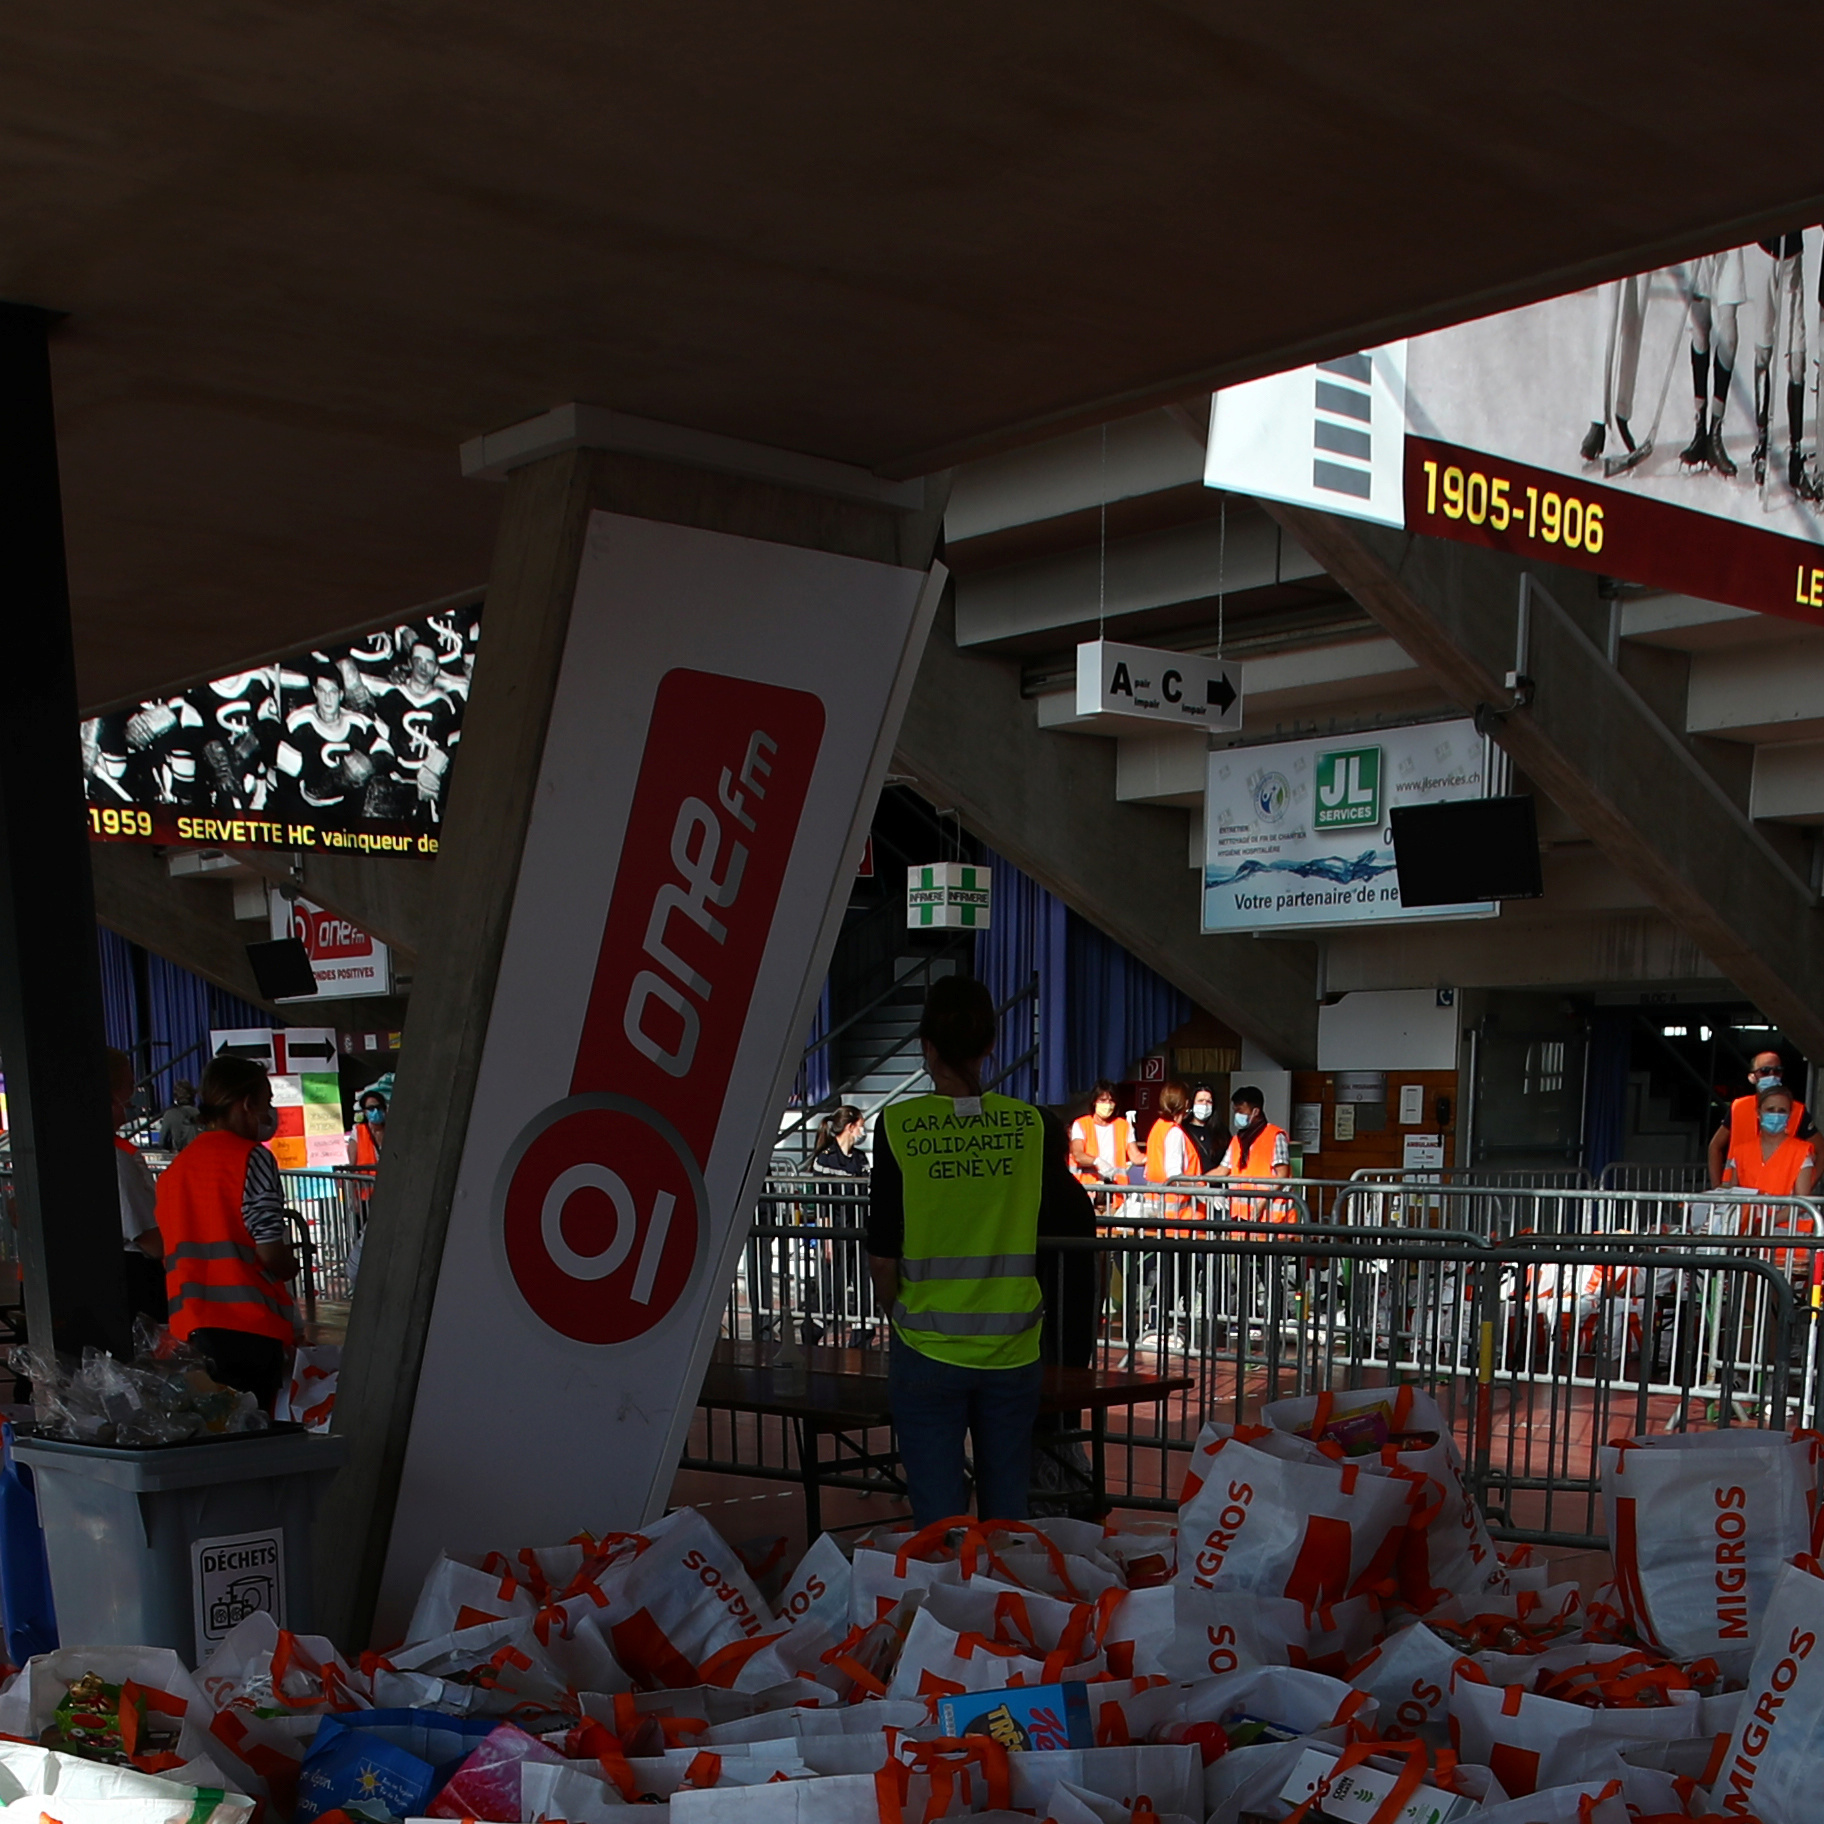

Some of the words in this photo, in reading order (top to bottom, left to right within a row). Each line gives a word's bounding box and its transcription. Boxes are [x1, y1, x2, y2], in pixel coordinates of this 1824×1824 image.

[1422, 460, 1605, 553] 1905-1906
[1110, 661, 1133, 697] A
[1162, 669, 1183, 703] C
[1319, 756, 1374, 807] JL
[1395, 772, 1481, 793] www.jlservices.ch
[1319, 805, 1373, 822] SERVICES
[177, 816, 283, 845] SERVETTE
[287, 823, 317, 847] HC
[321, 828, 414, 855] vainqueur
[909, 891, 944, 902] INFIRMERIE
[947, 891, 988, 903] INFIRMERIE
[1234, 891, 1273, 911] Votre
[1276, 887, 1352, 911] partenaire
[1356, 885, 1375, 902] de
[337, 967, 375, 979] POSITIVES
[901, 1110, 1012, 1134] CARAVANE
[1014, 1109, 1036, 1127] DE
[905, 1128, 1025, 1157] SOLIDARITÉ
[1406, 1141, 1440, 1149] AMBULANC
[928, 1152, 1014, 1180] GENÈVE
[1191, 1478, 1253, 1590] IGROS
[204, 1546, 277, 1573] DÉCHETS
[1714, 1485, 1748, 1640] MIGROS
[1721, 1625, 1817, 1817] MIGROS
[1332, 1776, 1350, 1800] CORN
